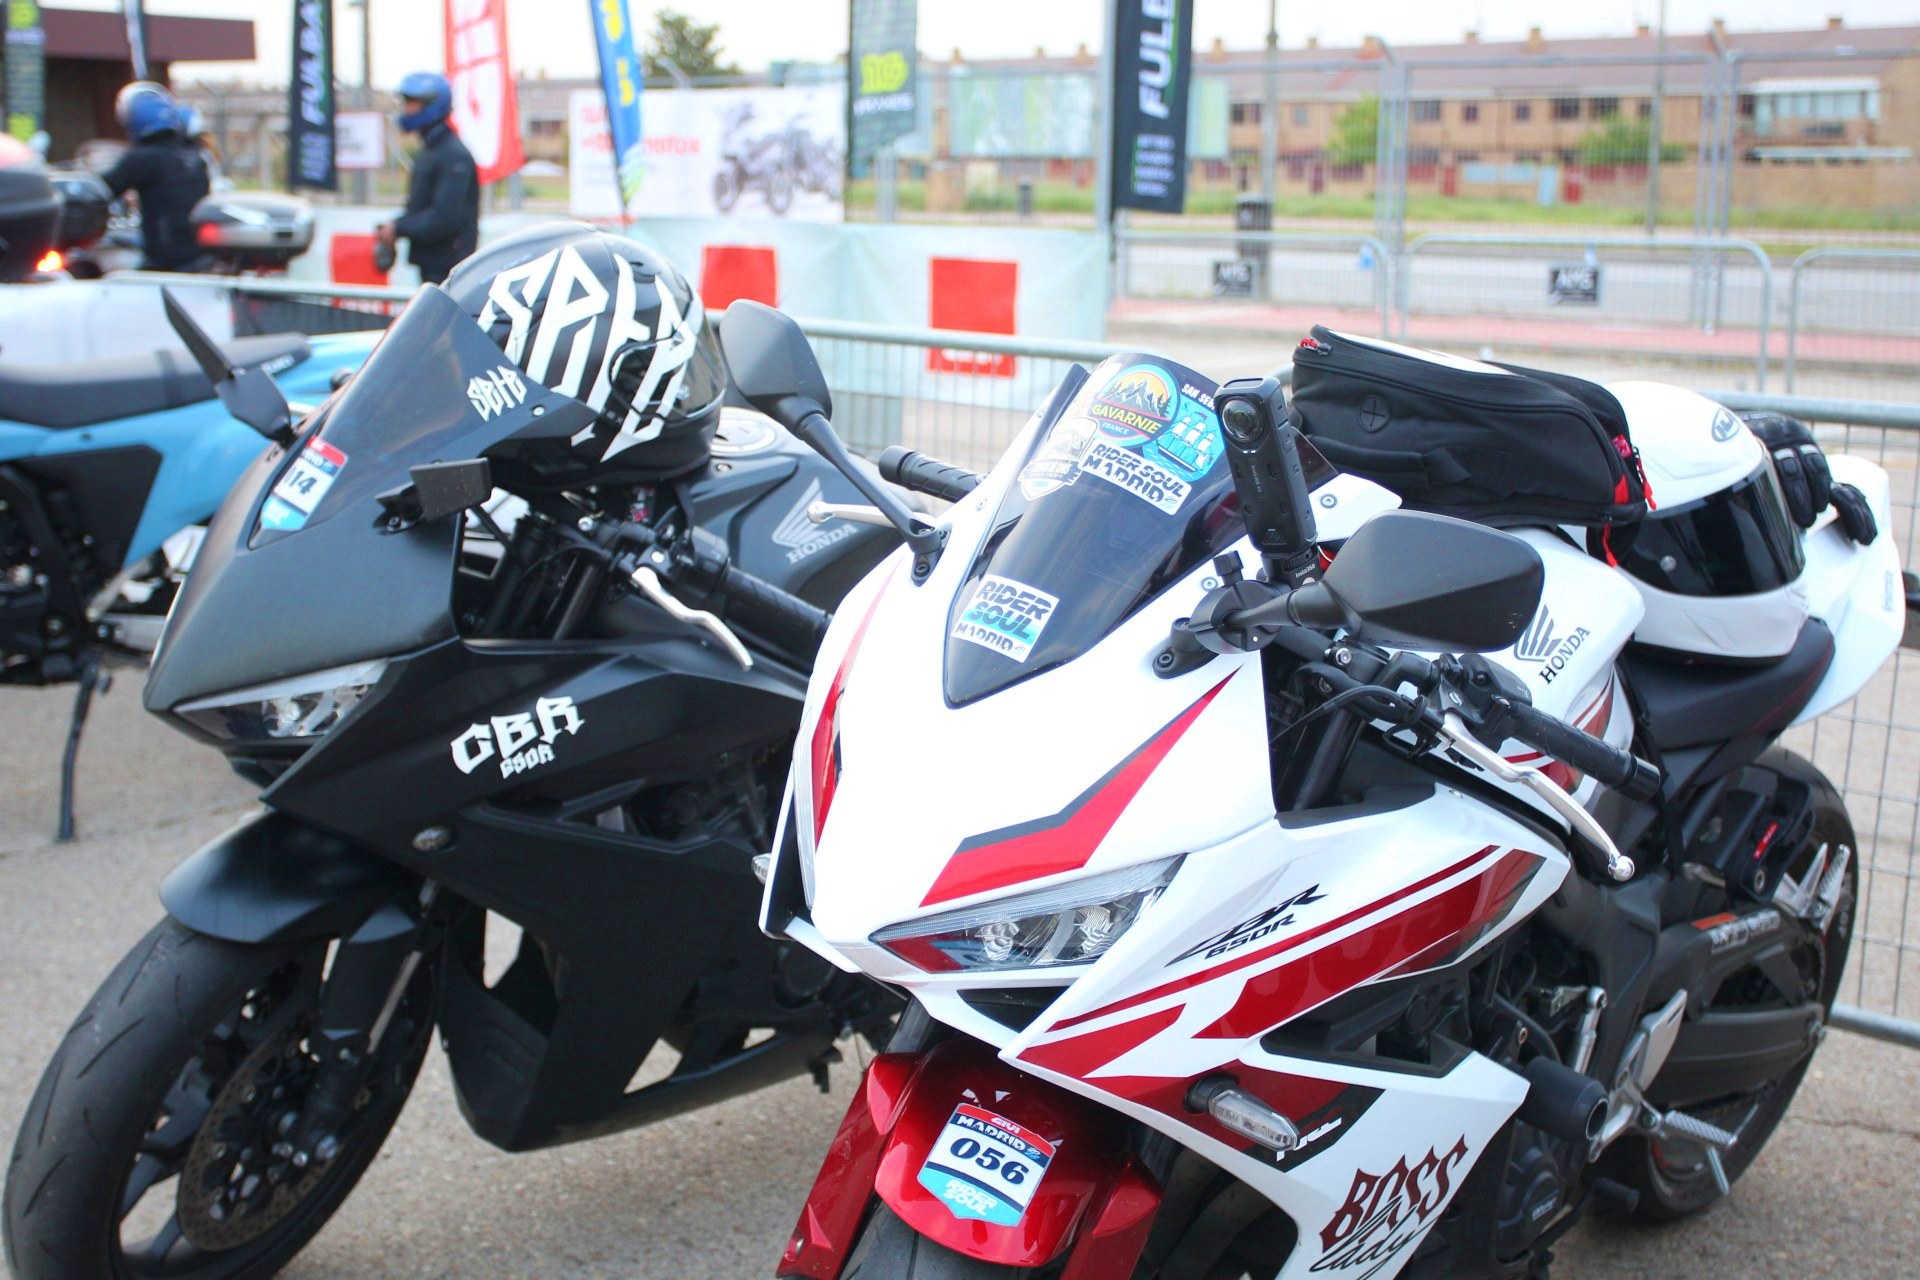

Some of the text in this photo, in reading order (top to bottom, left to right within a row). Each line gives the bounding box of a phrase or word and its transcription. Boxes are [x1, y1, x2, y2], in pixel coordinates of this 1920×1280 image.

[1181, 383, 1215, 410] SAN SEB
[1092, 404, 1162, 434] GAVARNIE
[1101, 421, 1130, 435] FRANCE
[1083, 455, 1164, 503] MADRID
[1092, 443, 1142, 473] RIDER
[1139, 465, 1184, 498] SOUL
[785, 523, 858, 564] HONDA
[976, 580, 1052, 620] RIDER
[956, 622, 1014, 651] MADRID
[968, 602, 1033, 640] SOUL
[1539, 626, 1591, 685] HONDA
[450, 696, 586, 774] CBR
[1164, 883, 1330, 968] CBR
[1204, 913, 1297, 960] 650R
[957, 1115, 1026, 1151] MADRID
[991, 1117, 1021, 1134] GIVI
[950, 1137, 1030, 1185] 056
[942, 1191, 988, 1216] SOUL
[945, 1179, 999, 1210] RIDER
[1319, 1133, 1469, 1254] BOSS
